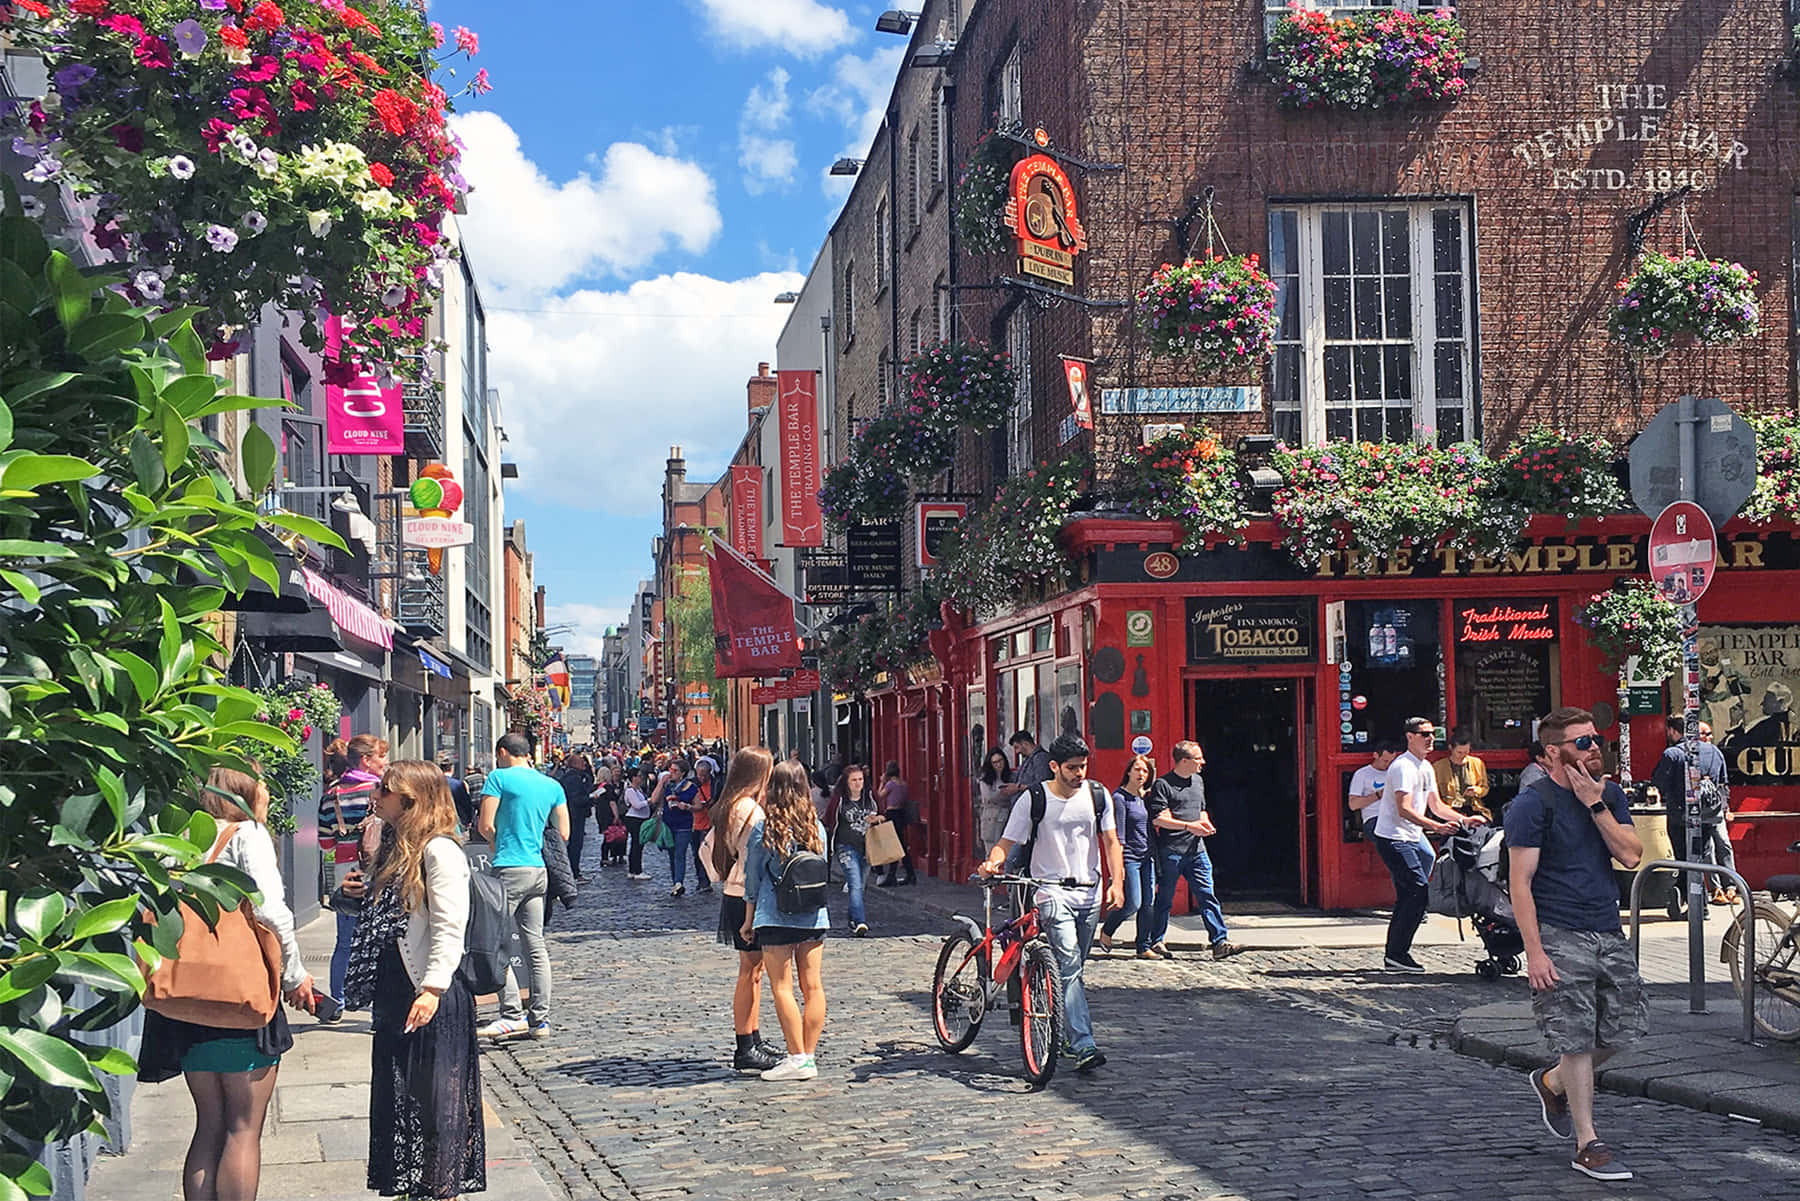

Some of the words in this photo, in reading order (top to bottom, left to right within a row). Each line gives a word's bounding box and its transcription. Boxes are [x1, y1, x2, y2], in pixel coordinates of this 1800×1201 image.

[1594, 84, 1667, 110] THE
[1511, 115, 1661, 170] TEMPLE
[1678, 120, 1750, 171] BAR
[1551, 168, 1634, 190] ESTD.
[1028, 261, 1047, 276] LIVE
[786, 402, 800, 429] BAR
[343, 430, 369, 439] CLOUD
[370, 430, 388, 440] NINE
[802, 422, 812, 440] CO.
[788, 431, 802, 489] TEMPLE
[802, 443, 814, 498] TRADING
[746, 487, 756, 509] THE
[790, 491, 803, 519] THE
[407, 522, 438, 533] CLOUD
[440, 522, 464, 535] NINE
[746, 511, 757, 546] TEMPLE
[861, 517, 888, 526] BAR
[1150, 556, 1171, 571] 48
[1316, 549, 1415, 577] THE
[1434, 544, 1639, 575] TEMPLE
[1192, 602, 1243, 624] Importers
[1258, 617, 1298, 626] SMOKING
[1462, 603, 1549, 624] Traditional
[735, 631, 792, 648] TEMPLE
[751, 626, 775, 636] THE
[1460, 624, 1500, 641] Irish
[1507, 623, 1554, 640] Music
[751, 645, 781, 657] BAR
[1225, 647, 1260, 656] Always
[1279, 647, 1307, 656] Stock
[1478, 650, 1515, 667] TEMPLE
[1743, 650, 1788, 667] BAR
